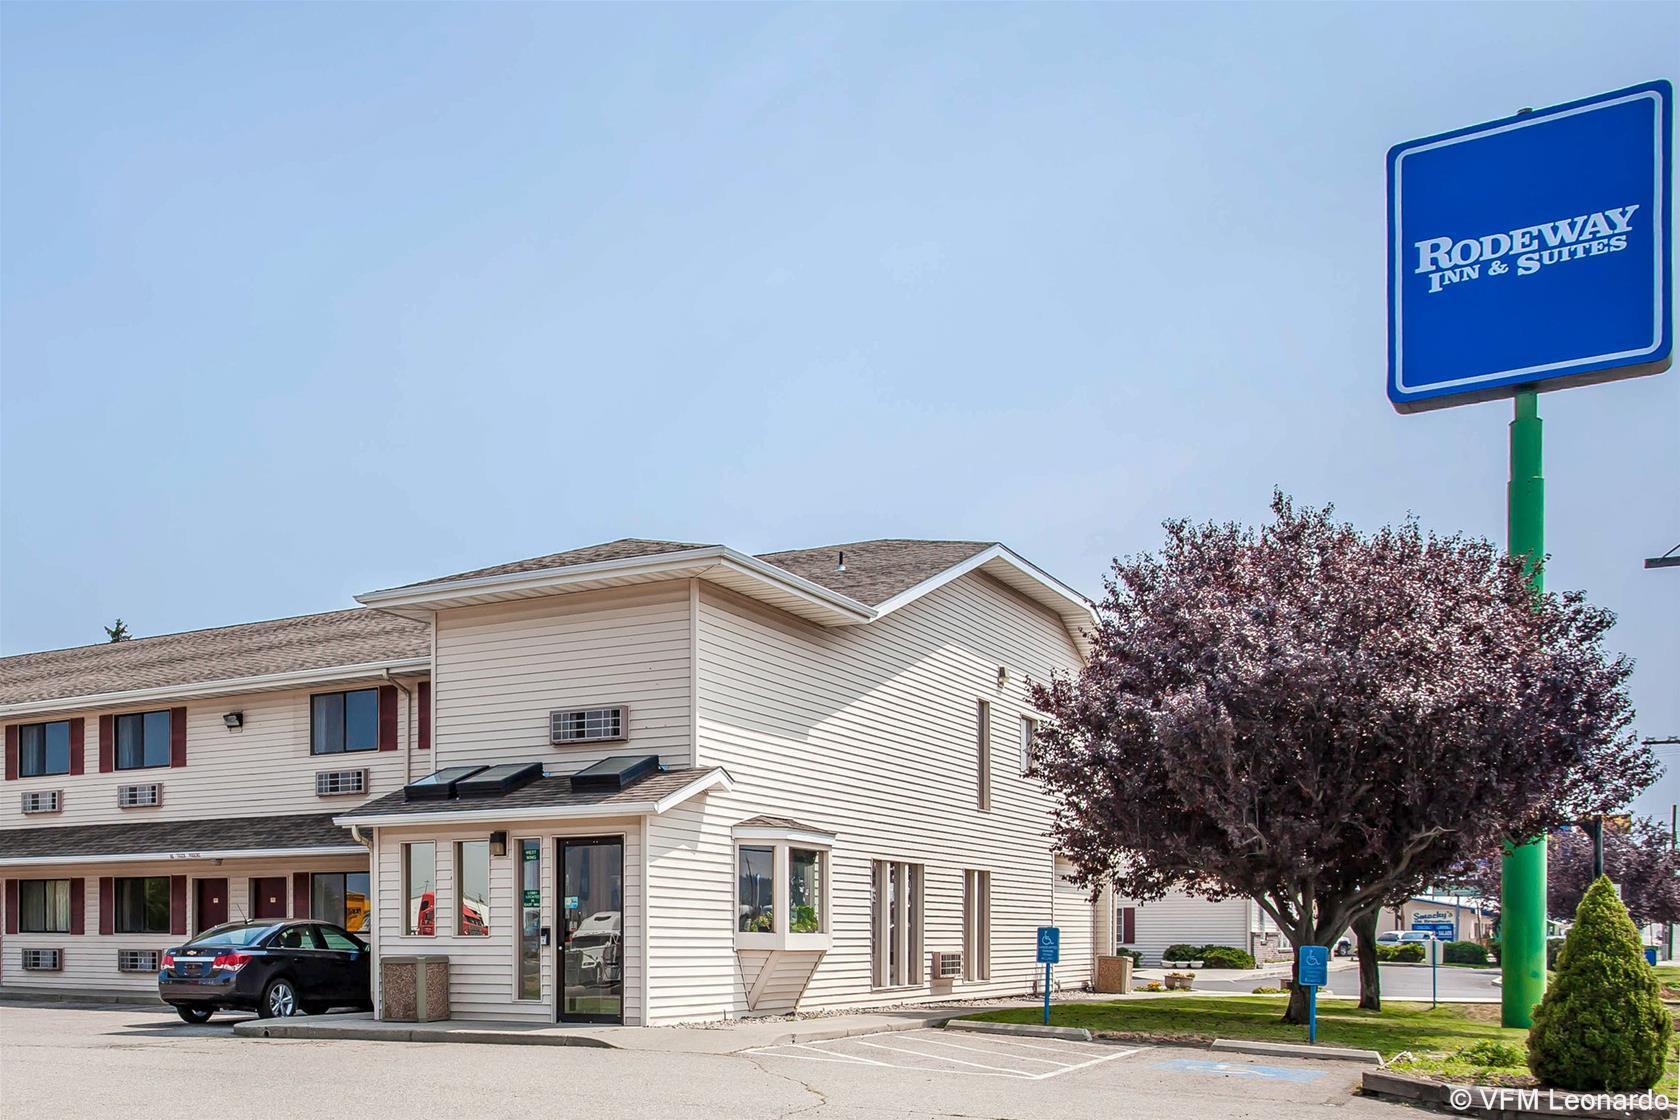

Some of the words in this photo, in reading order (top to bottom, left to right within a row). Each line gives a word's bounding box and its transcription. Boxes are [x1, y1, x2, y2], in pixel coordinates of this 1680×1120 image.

[1414, 204, 1640, 274] RODEWAY
[1428, 264, 1481, 293] INN
[1488, 260, 1509, 276] &
[1517, 235, 1628, 276] SUITES
